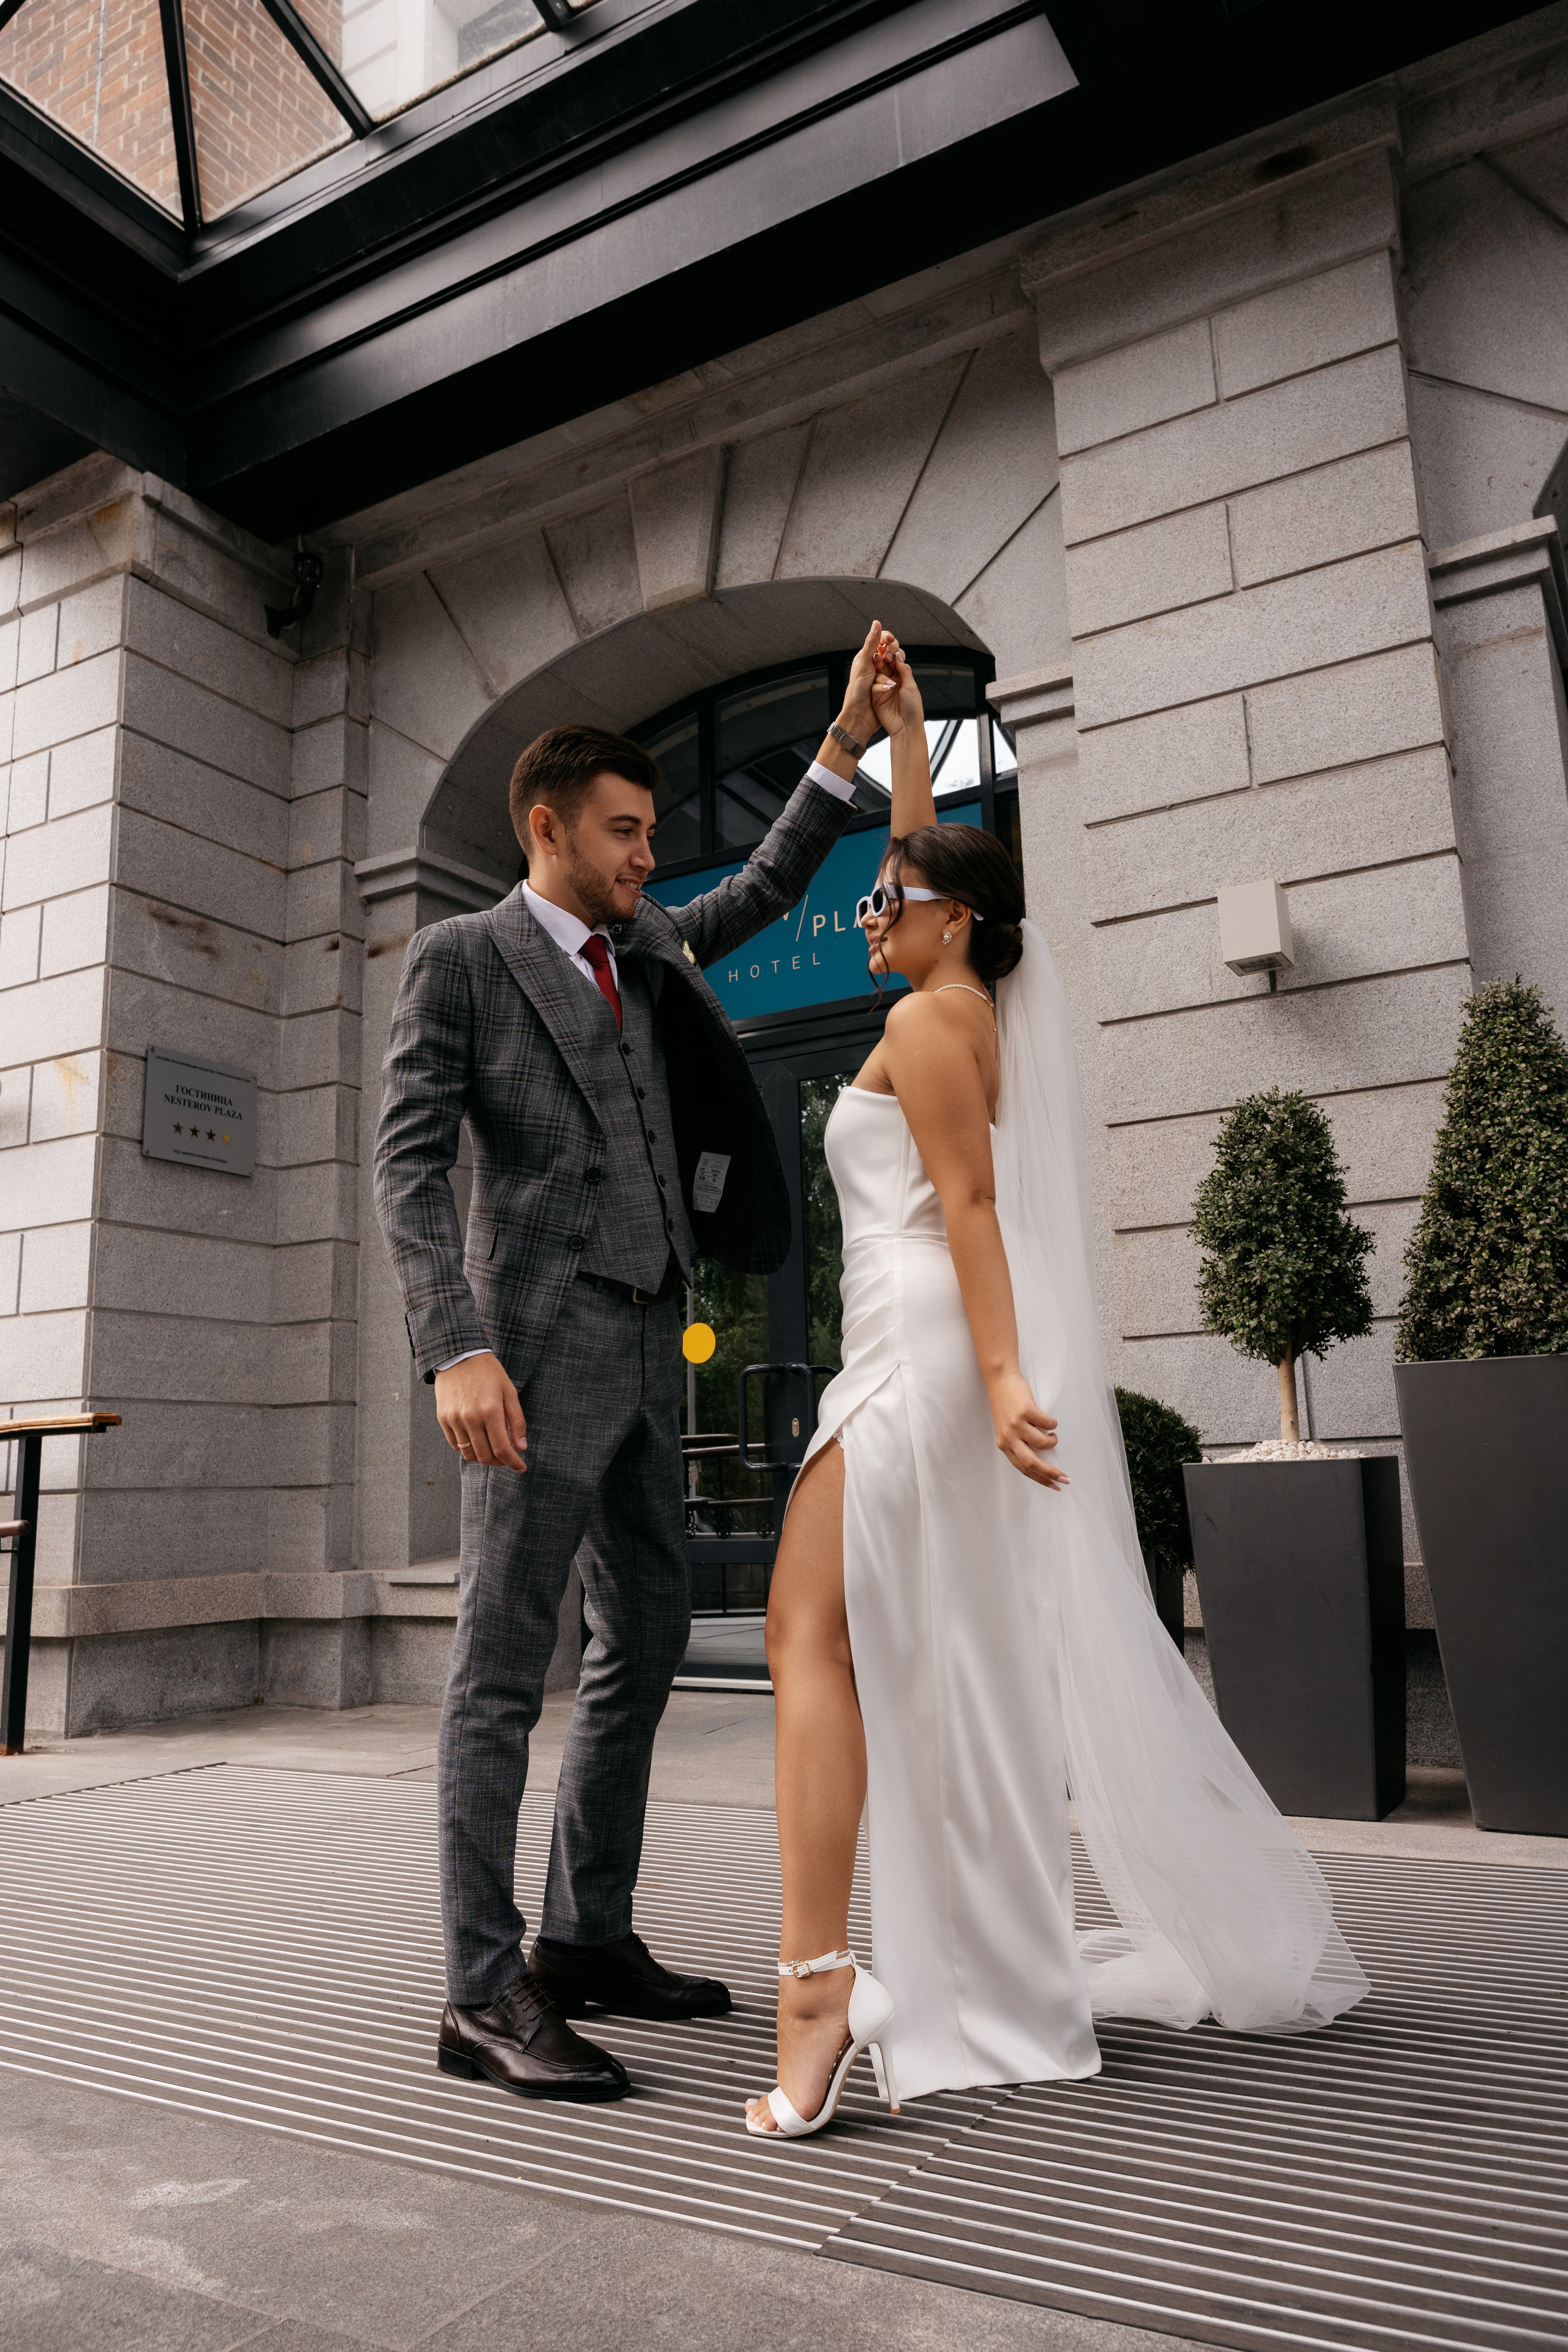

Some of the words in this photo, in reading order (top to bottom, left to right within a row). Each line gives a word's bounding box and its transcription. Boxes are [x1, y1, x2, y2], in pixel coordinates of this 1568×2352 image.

[728, 952, 821, 982] HOTEL
[164, 1094, 213, 1112] NESTEROV
[214, 1106, 243, 1120] PLAZA
[176, 1085, 233, 1106] ГОСТИНИЦА
